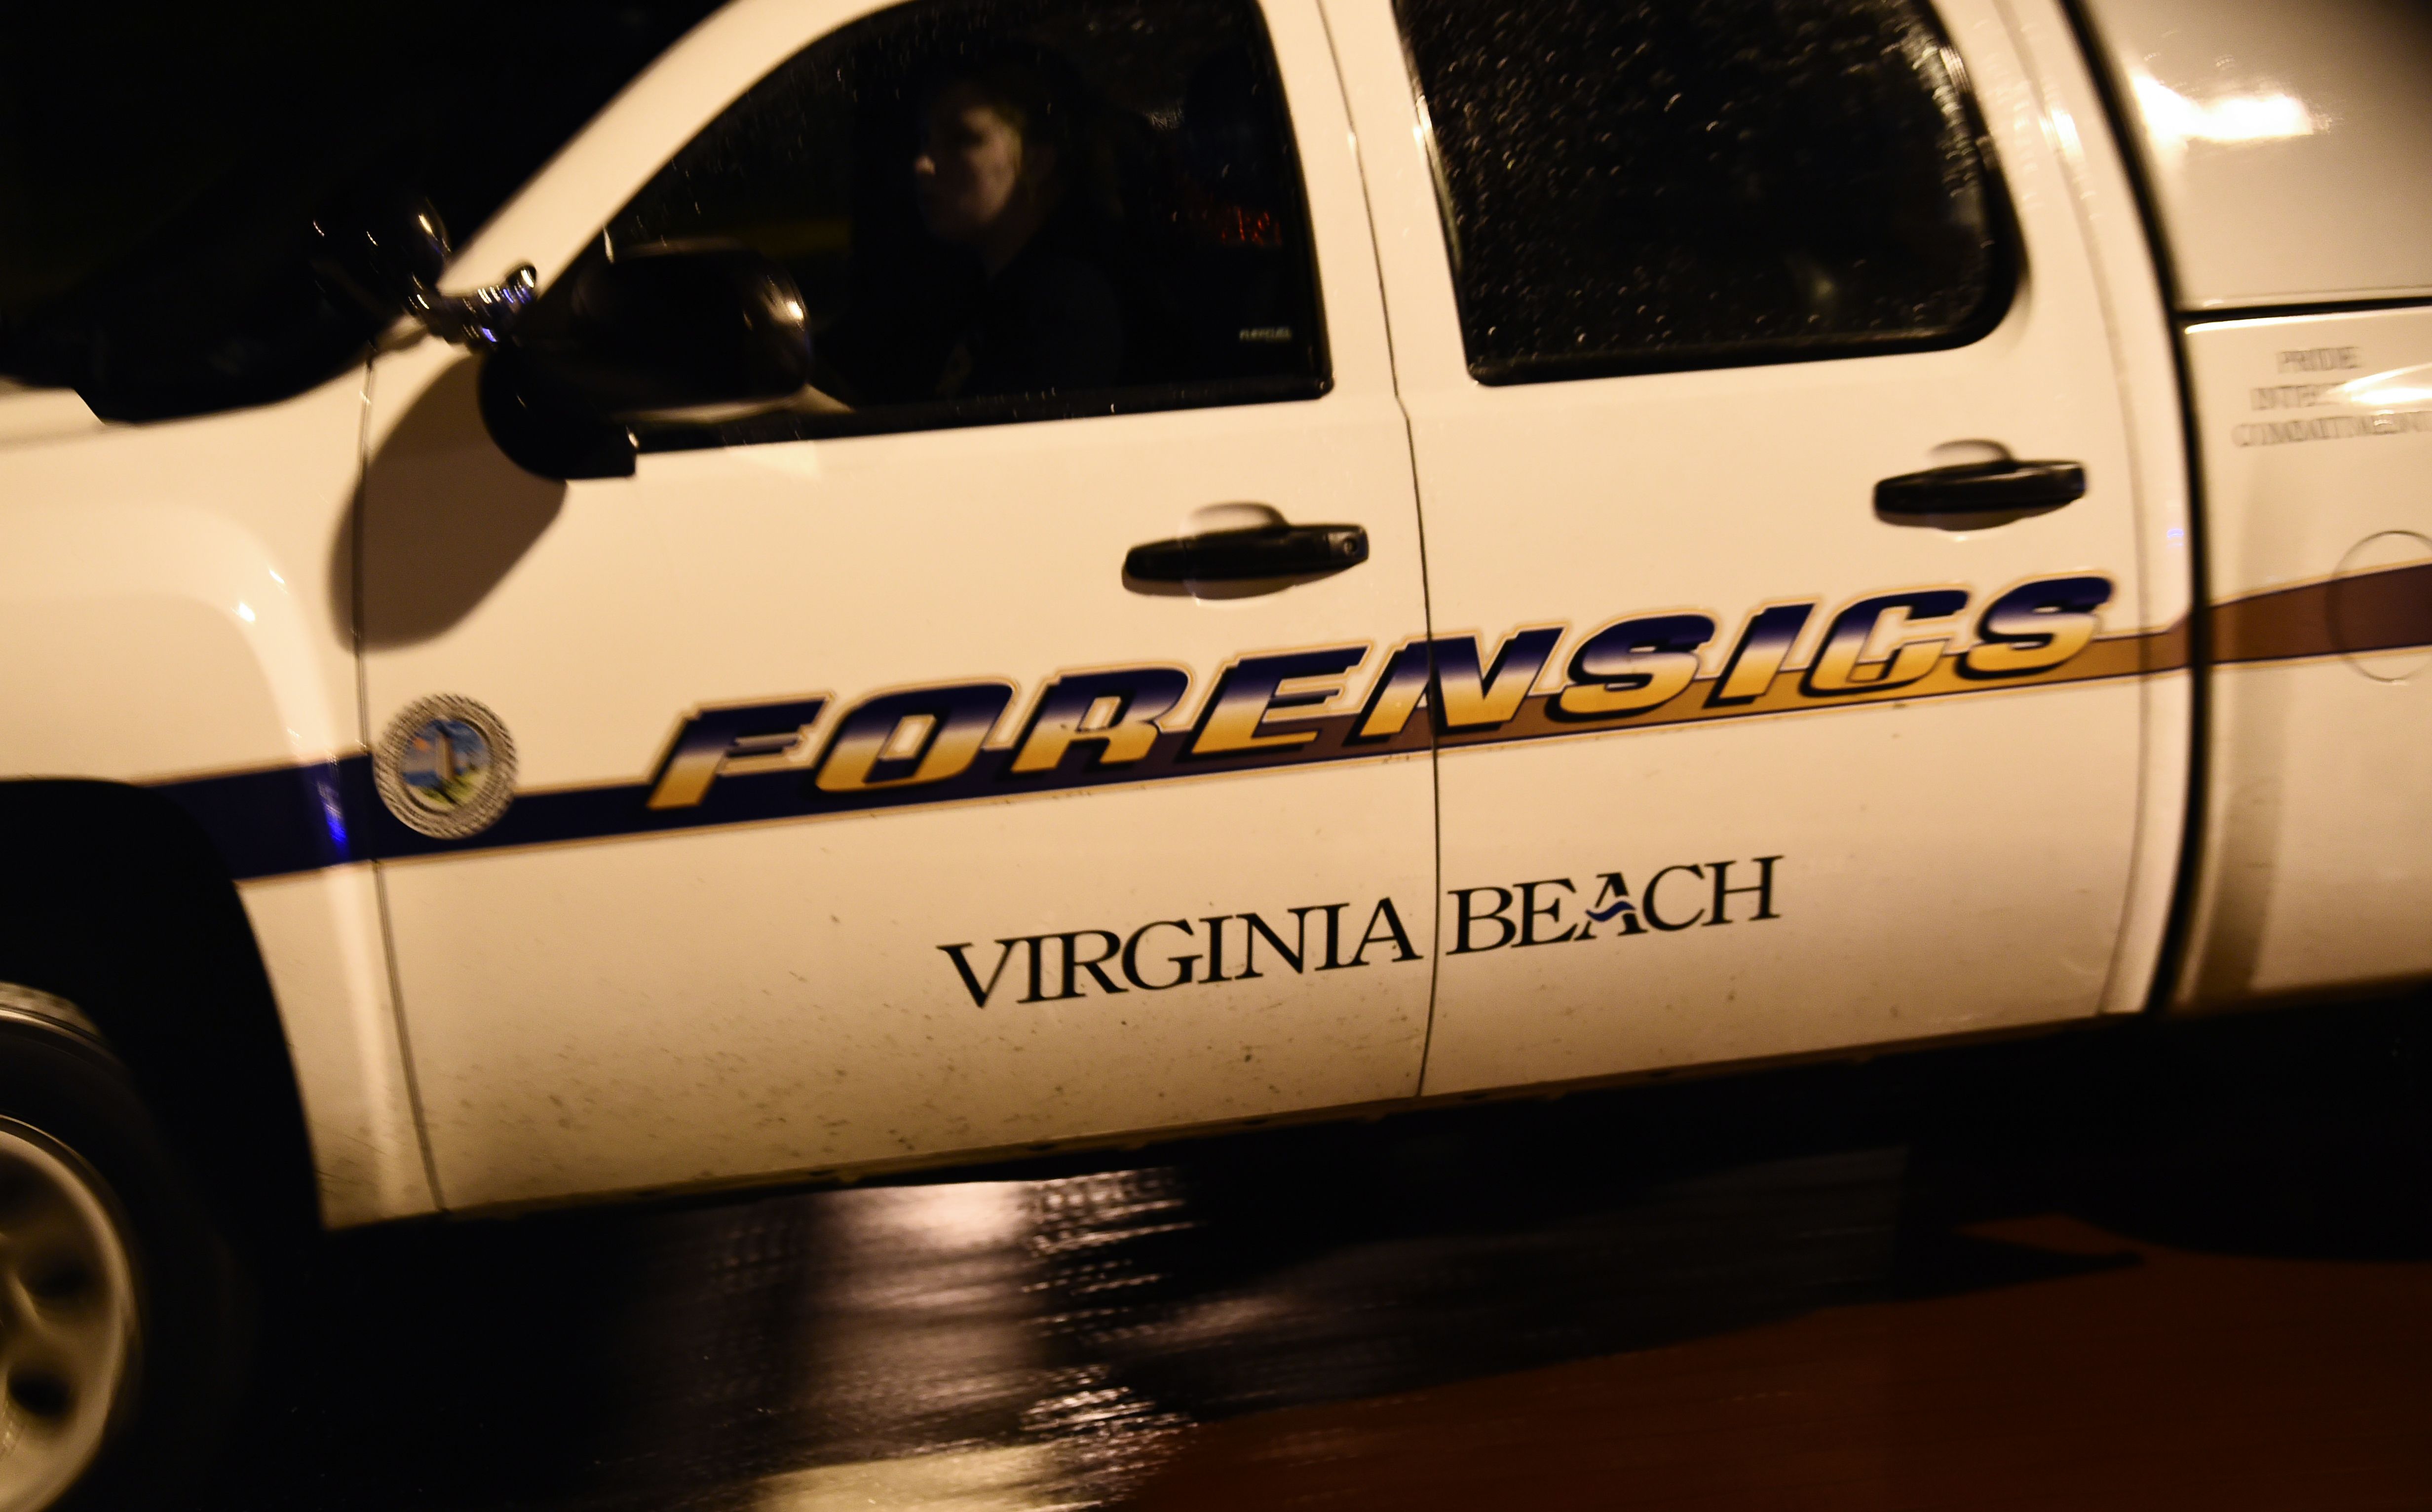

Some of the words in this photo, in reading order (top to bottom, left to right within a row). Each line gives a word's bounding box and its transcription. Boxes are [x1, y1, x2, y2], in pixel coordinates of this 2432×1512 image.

[644, 574, 2115, 811] FORENSICS
[937, 897, 1424, 1009] VIRGINIA
[1445, 856, 1783, 956] BEACH
